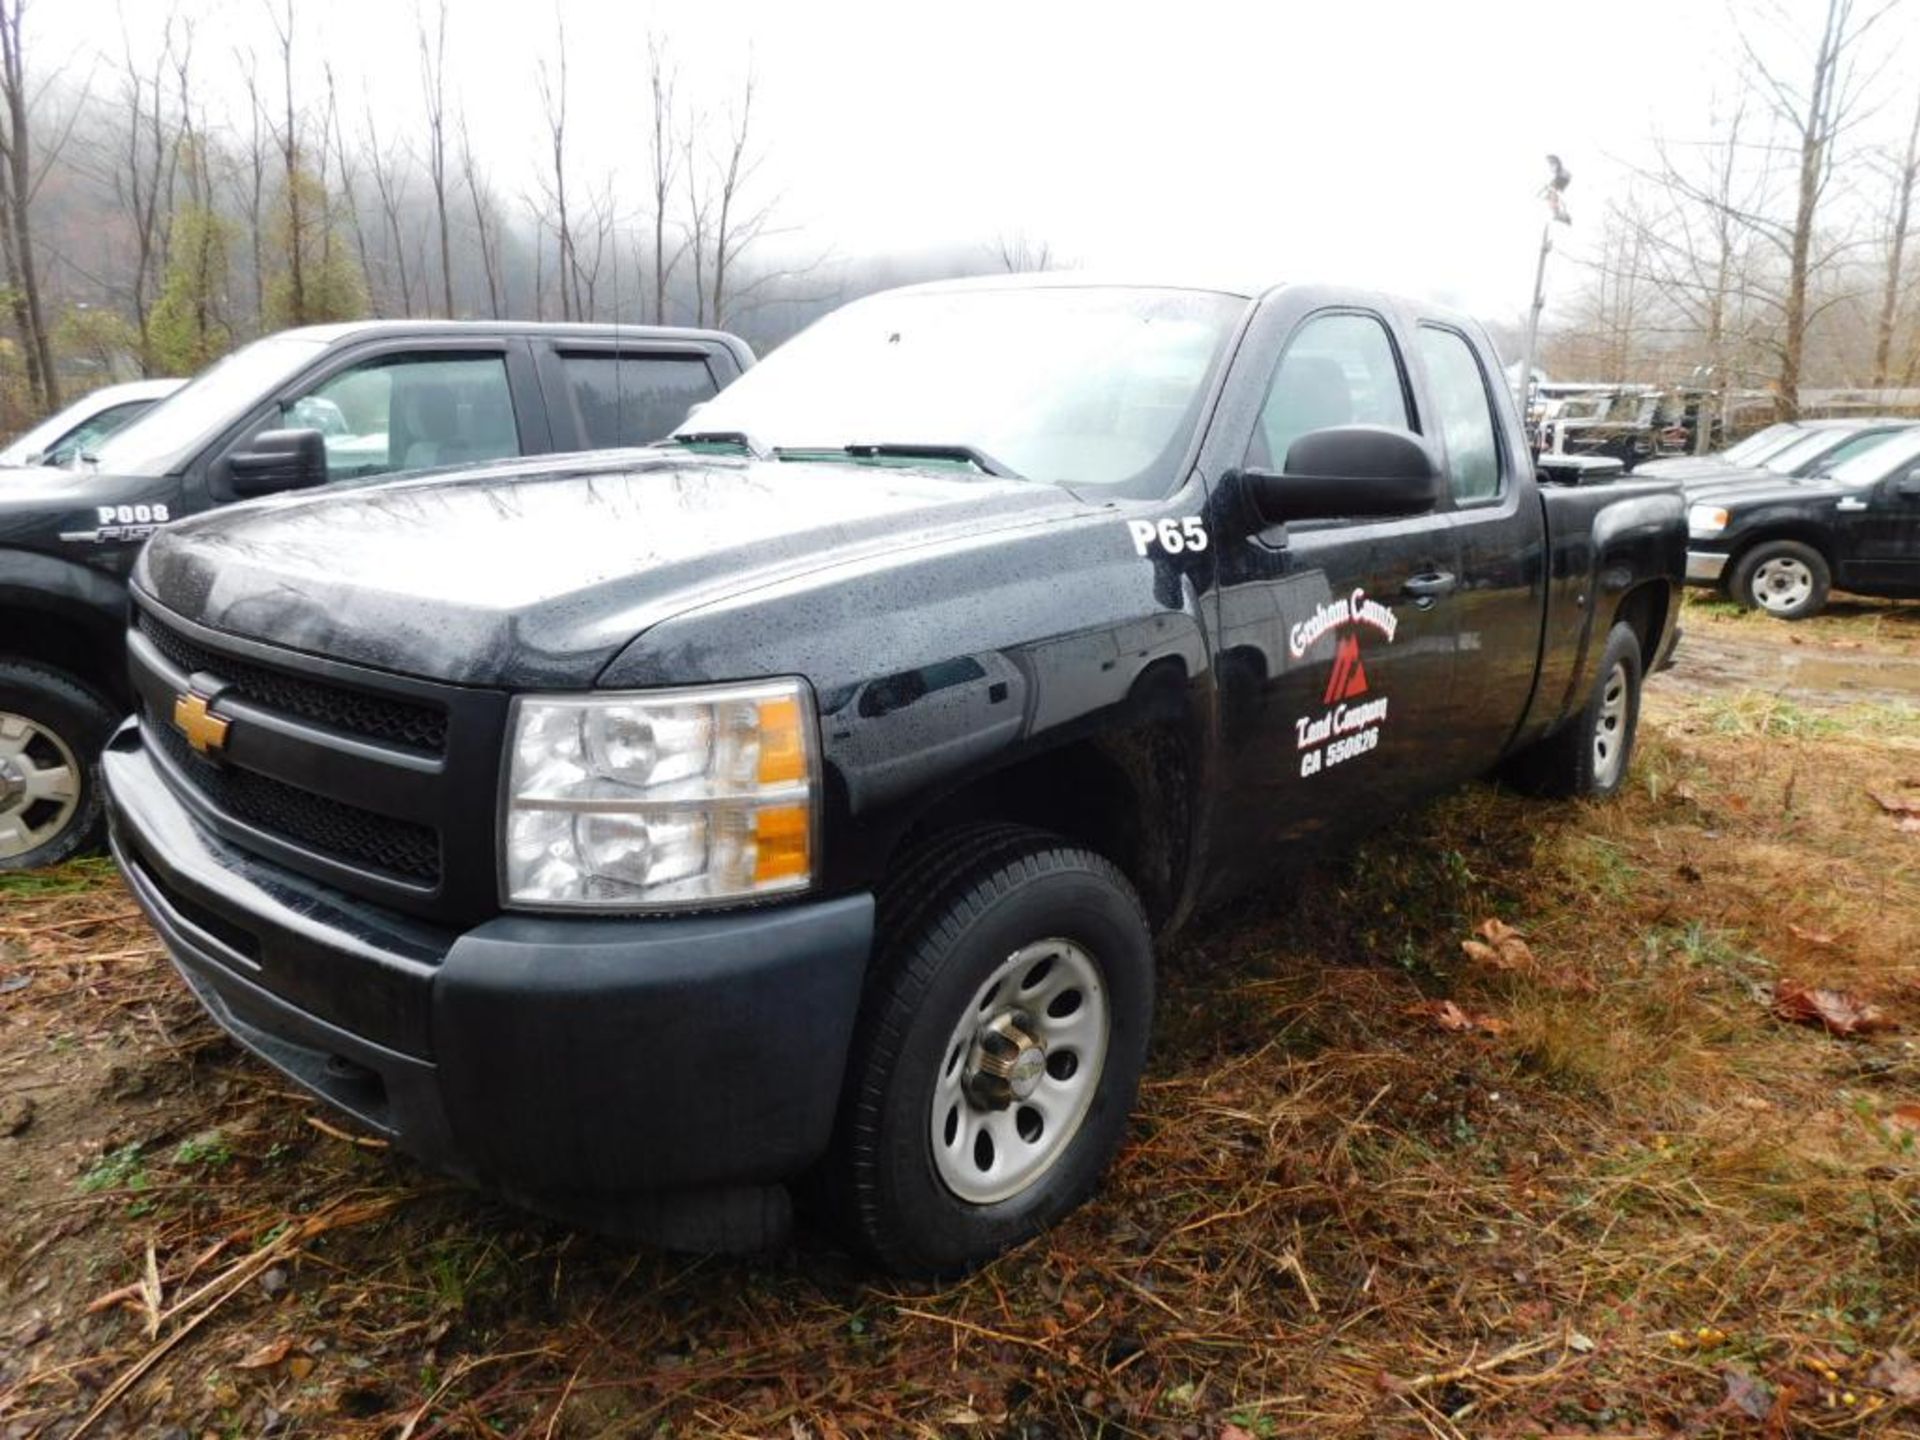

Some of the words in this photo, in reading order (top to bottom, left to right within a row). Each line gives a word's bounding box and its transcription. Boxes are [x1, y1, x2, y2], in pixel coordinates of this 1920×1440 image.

[97, 504, 169, 524] P008
[1127, 516, 1208, 556] P65
[1290, 598, 1349, 657] Graham
[1350, 587, 1398, 643] County
[1296, 710, 1332, 749] Land
[1333, 697, 1388, 735] Company
